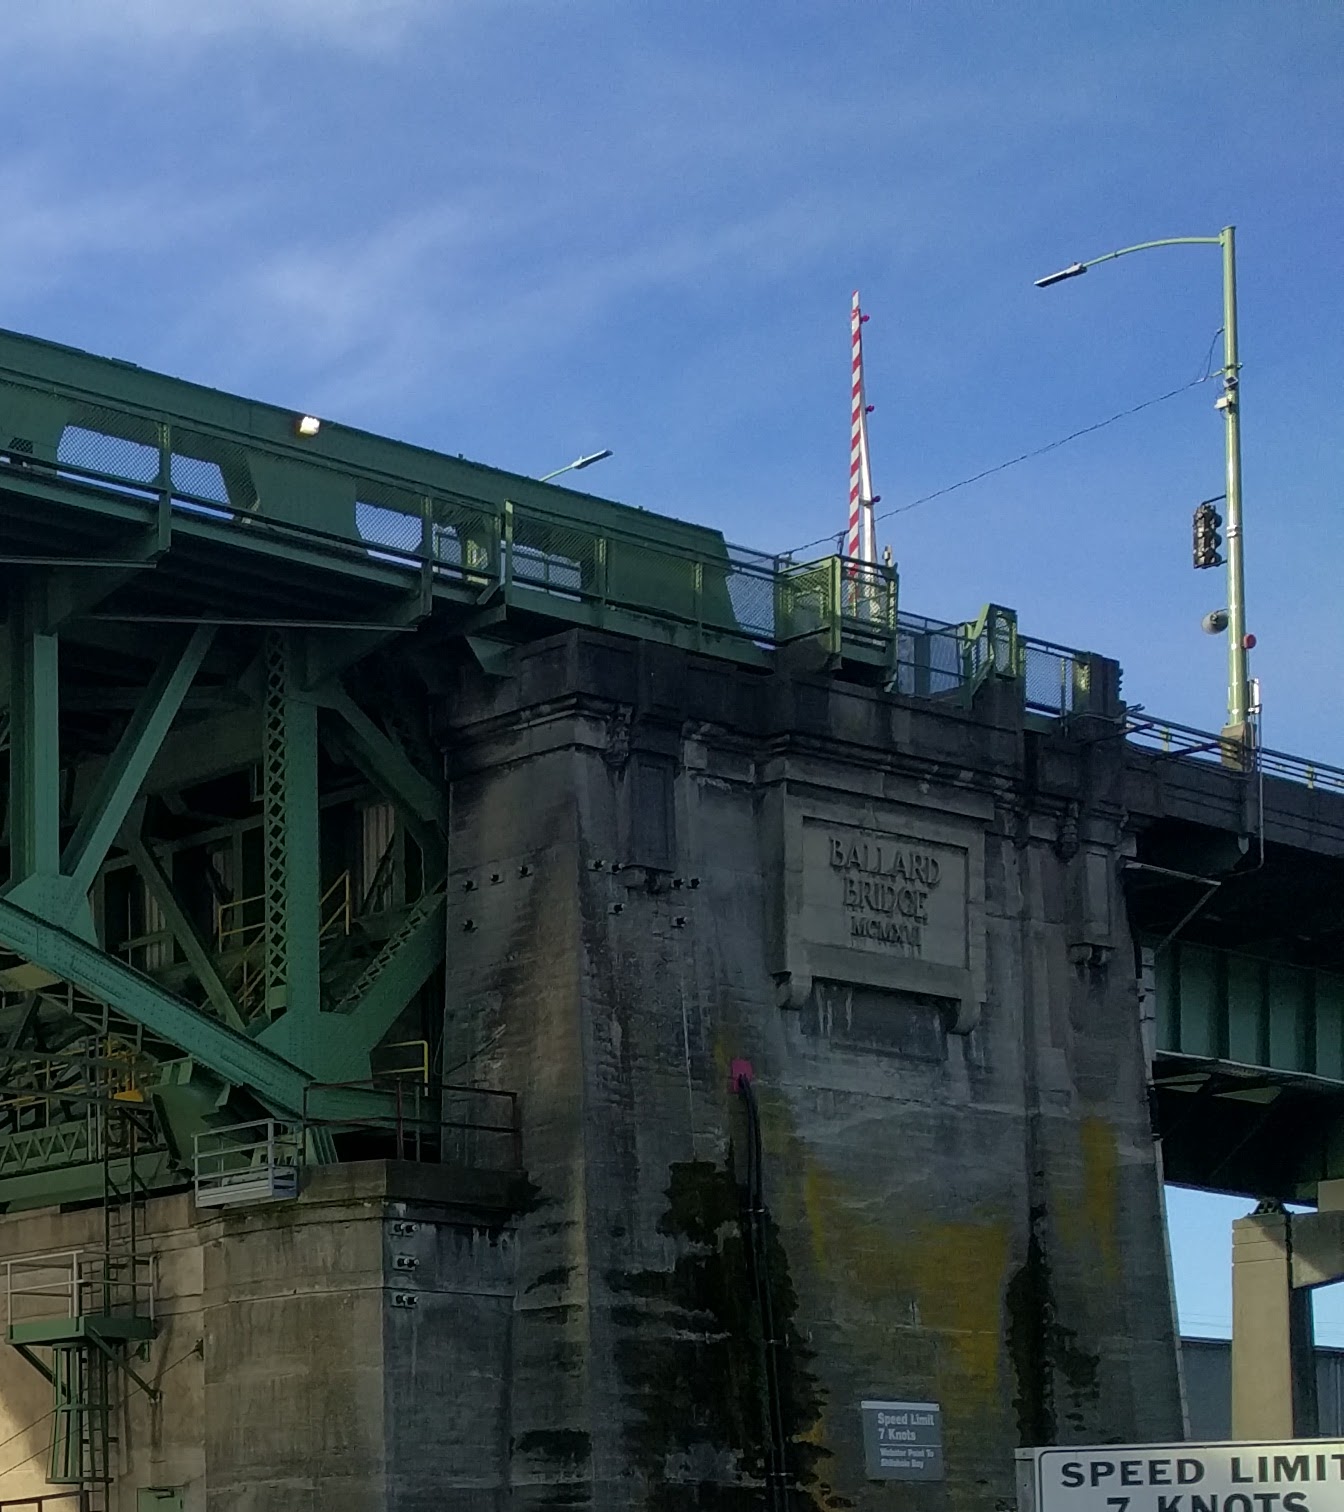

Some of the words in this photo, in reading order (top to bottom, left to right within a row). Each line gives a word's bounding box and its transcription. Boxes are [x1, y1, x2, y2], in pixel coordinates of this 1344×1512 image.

[829, 836, 943, 889] BALLARD
[842, 876, 929, 921] BRIDGE
[877, 1412, 908, 1426] Speed
[910, 1413, 935, 1426] Limit
[878, 1428, 885, 1440] 7
[888, 1429, 917, 1441] Knots
[1061, 1458, 1206, 1488] SPEED
